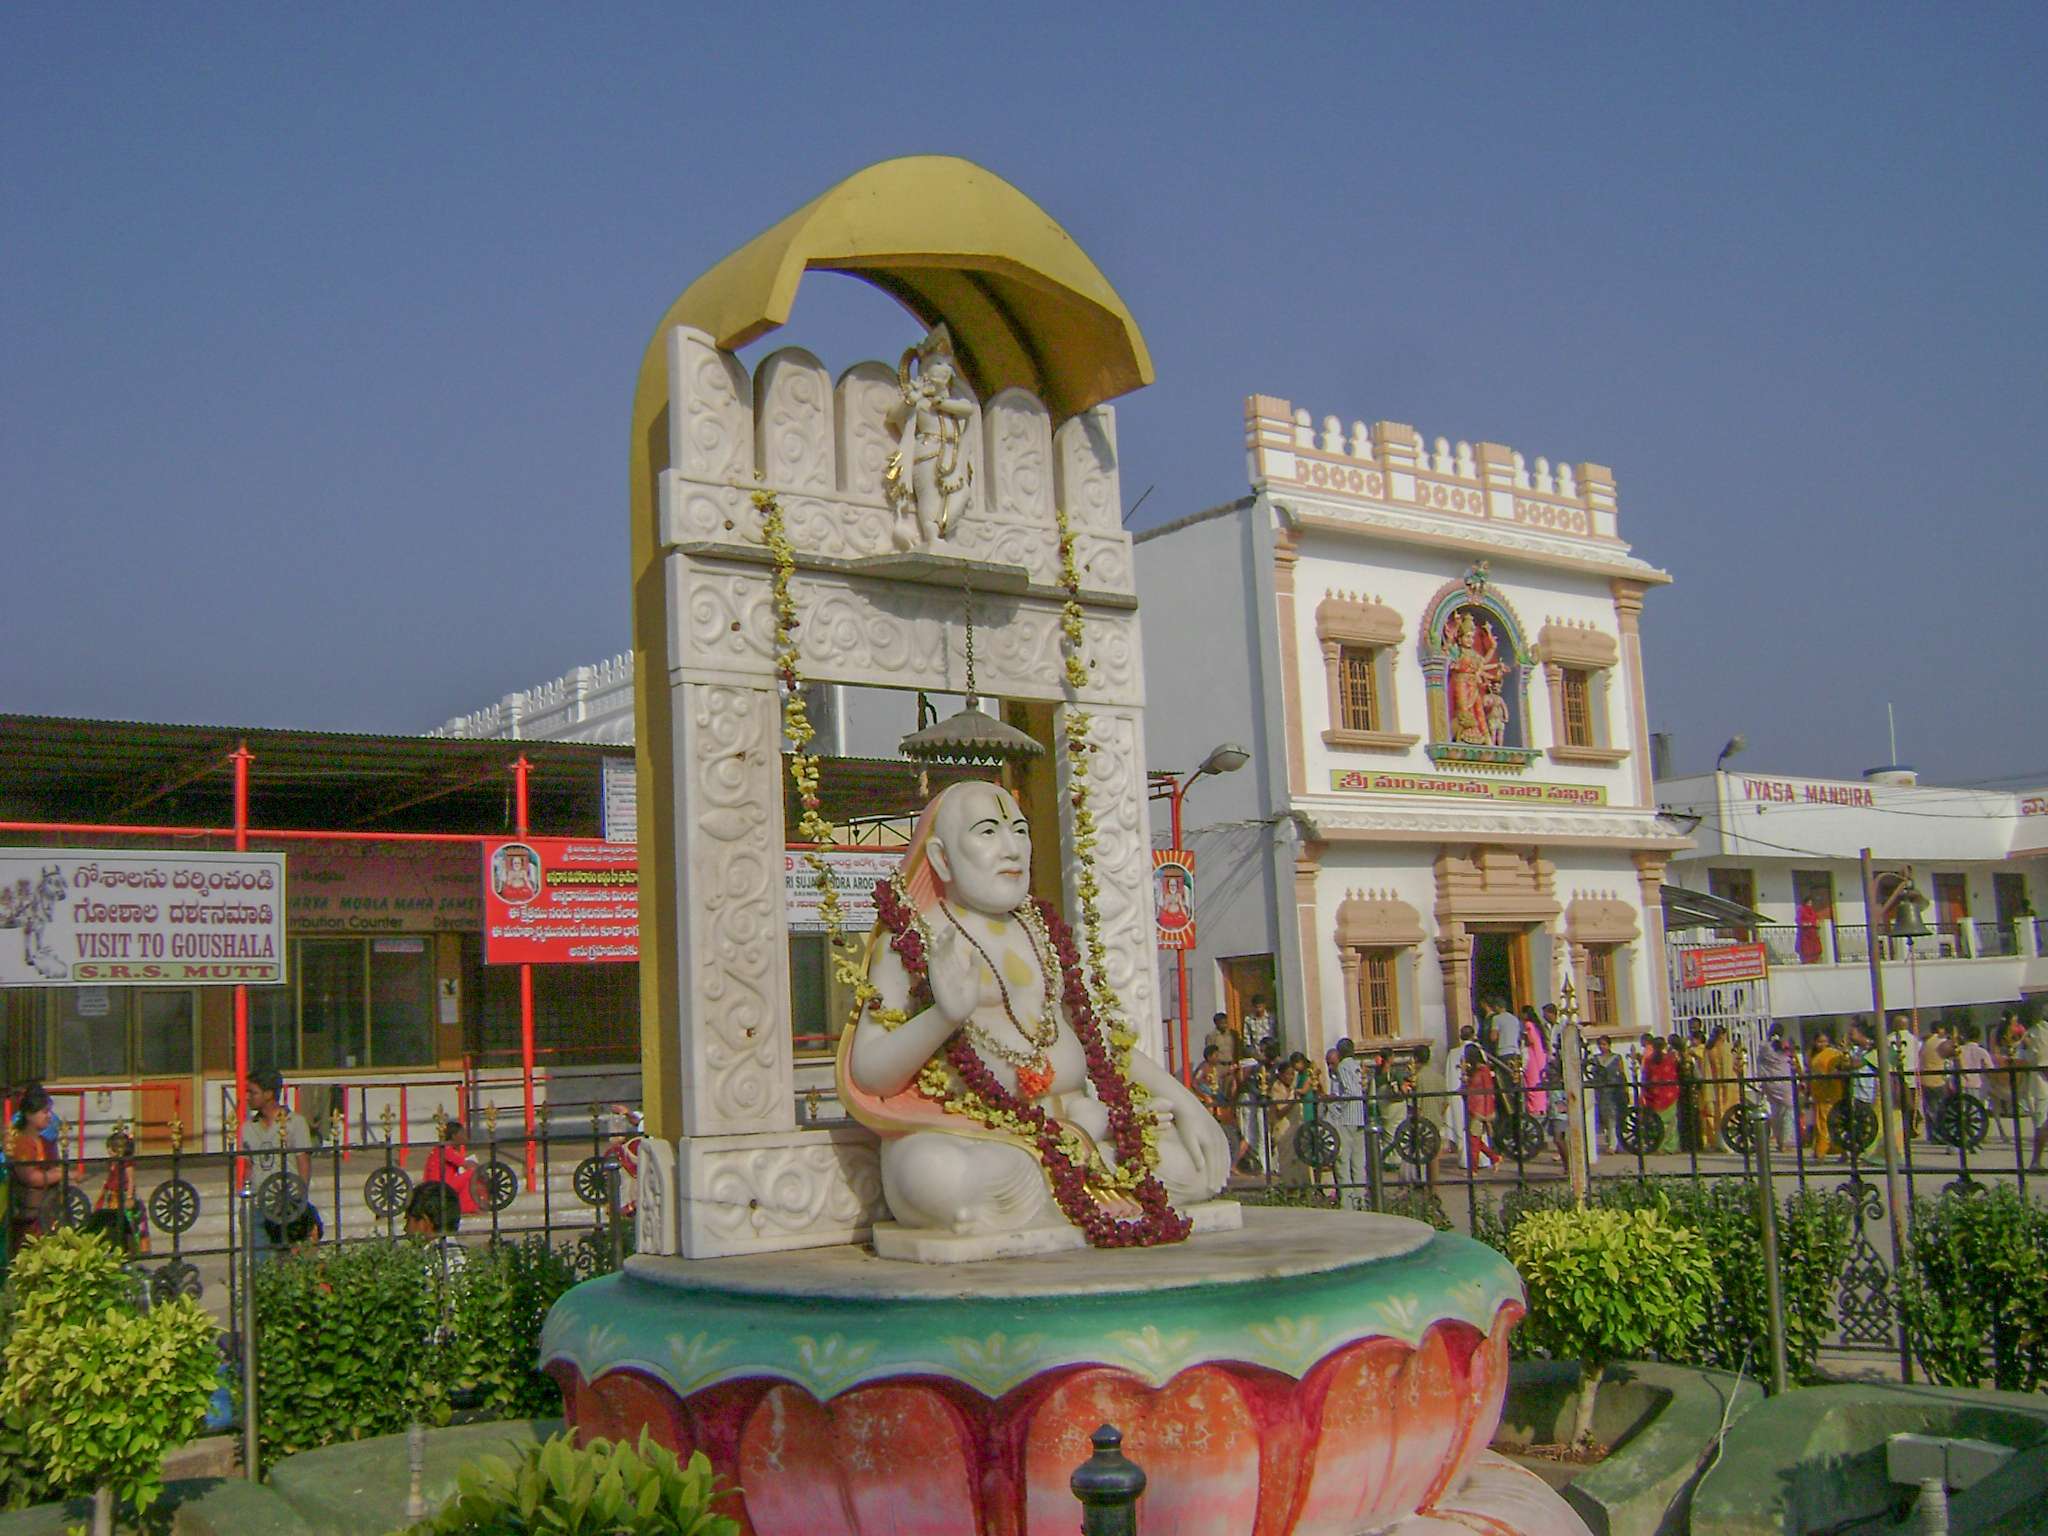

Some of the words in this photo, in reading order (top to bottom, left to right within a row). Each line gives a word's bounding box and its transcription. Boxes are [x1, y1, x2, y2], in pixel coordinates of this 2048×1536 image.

[1743, 779, 1795, 802] VYASA
[1804, 784, 1873, 807] MANDIRA
[349, 915, 404, 929] Counter
[76, 933, 132, 958] VISIT
[138, 933, 165, 958] TO
[172, 933, 275, 958] GOUSHALA
[79, 965, 170, 979] S.R.S.
[183, 965, 274, 979] MUTT
